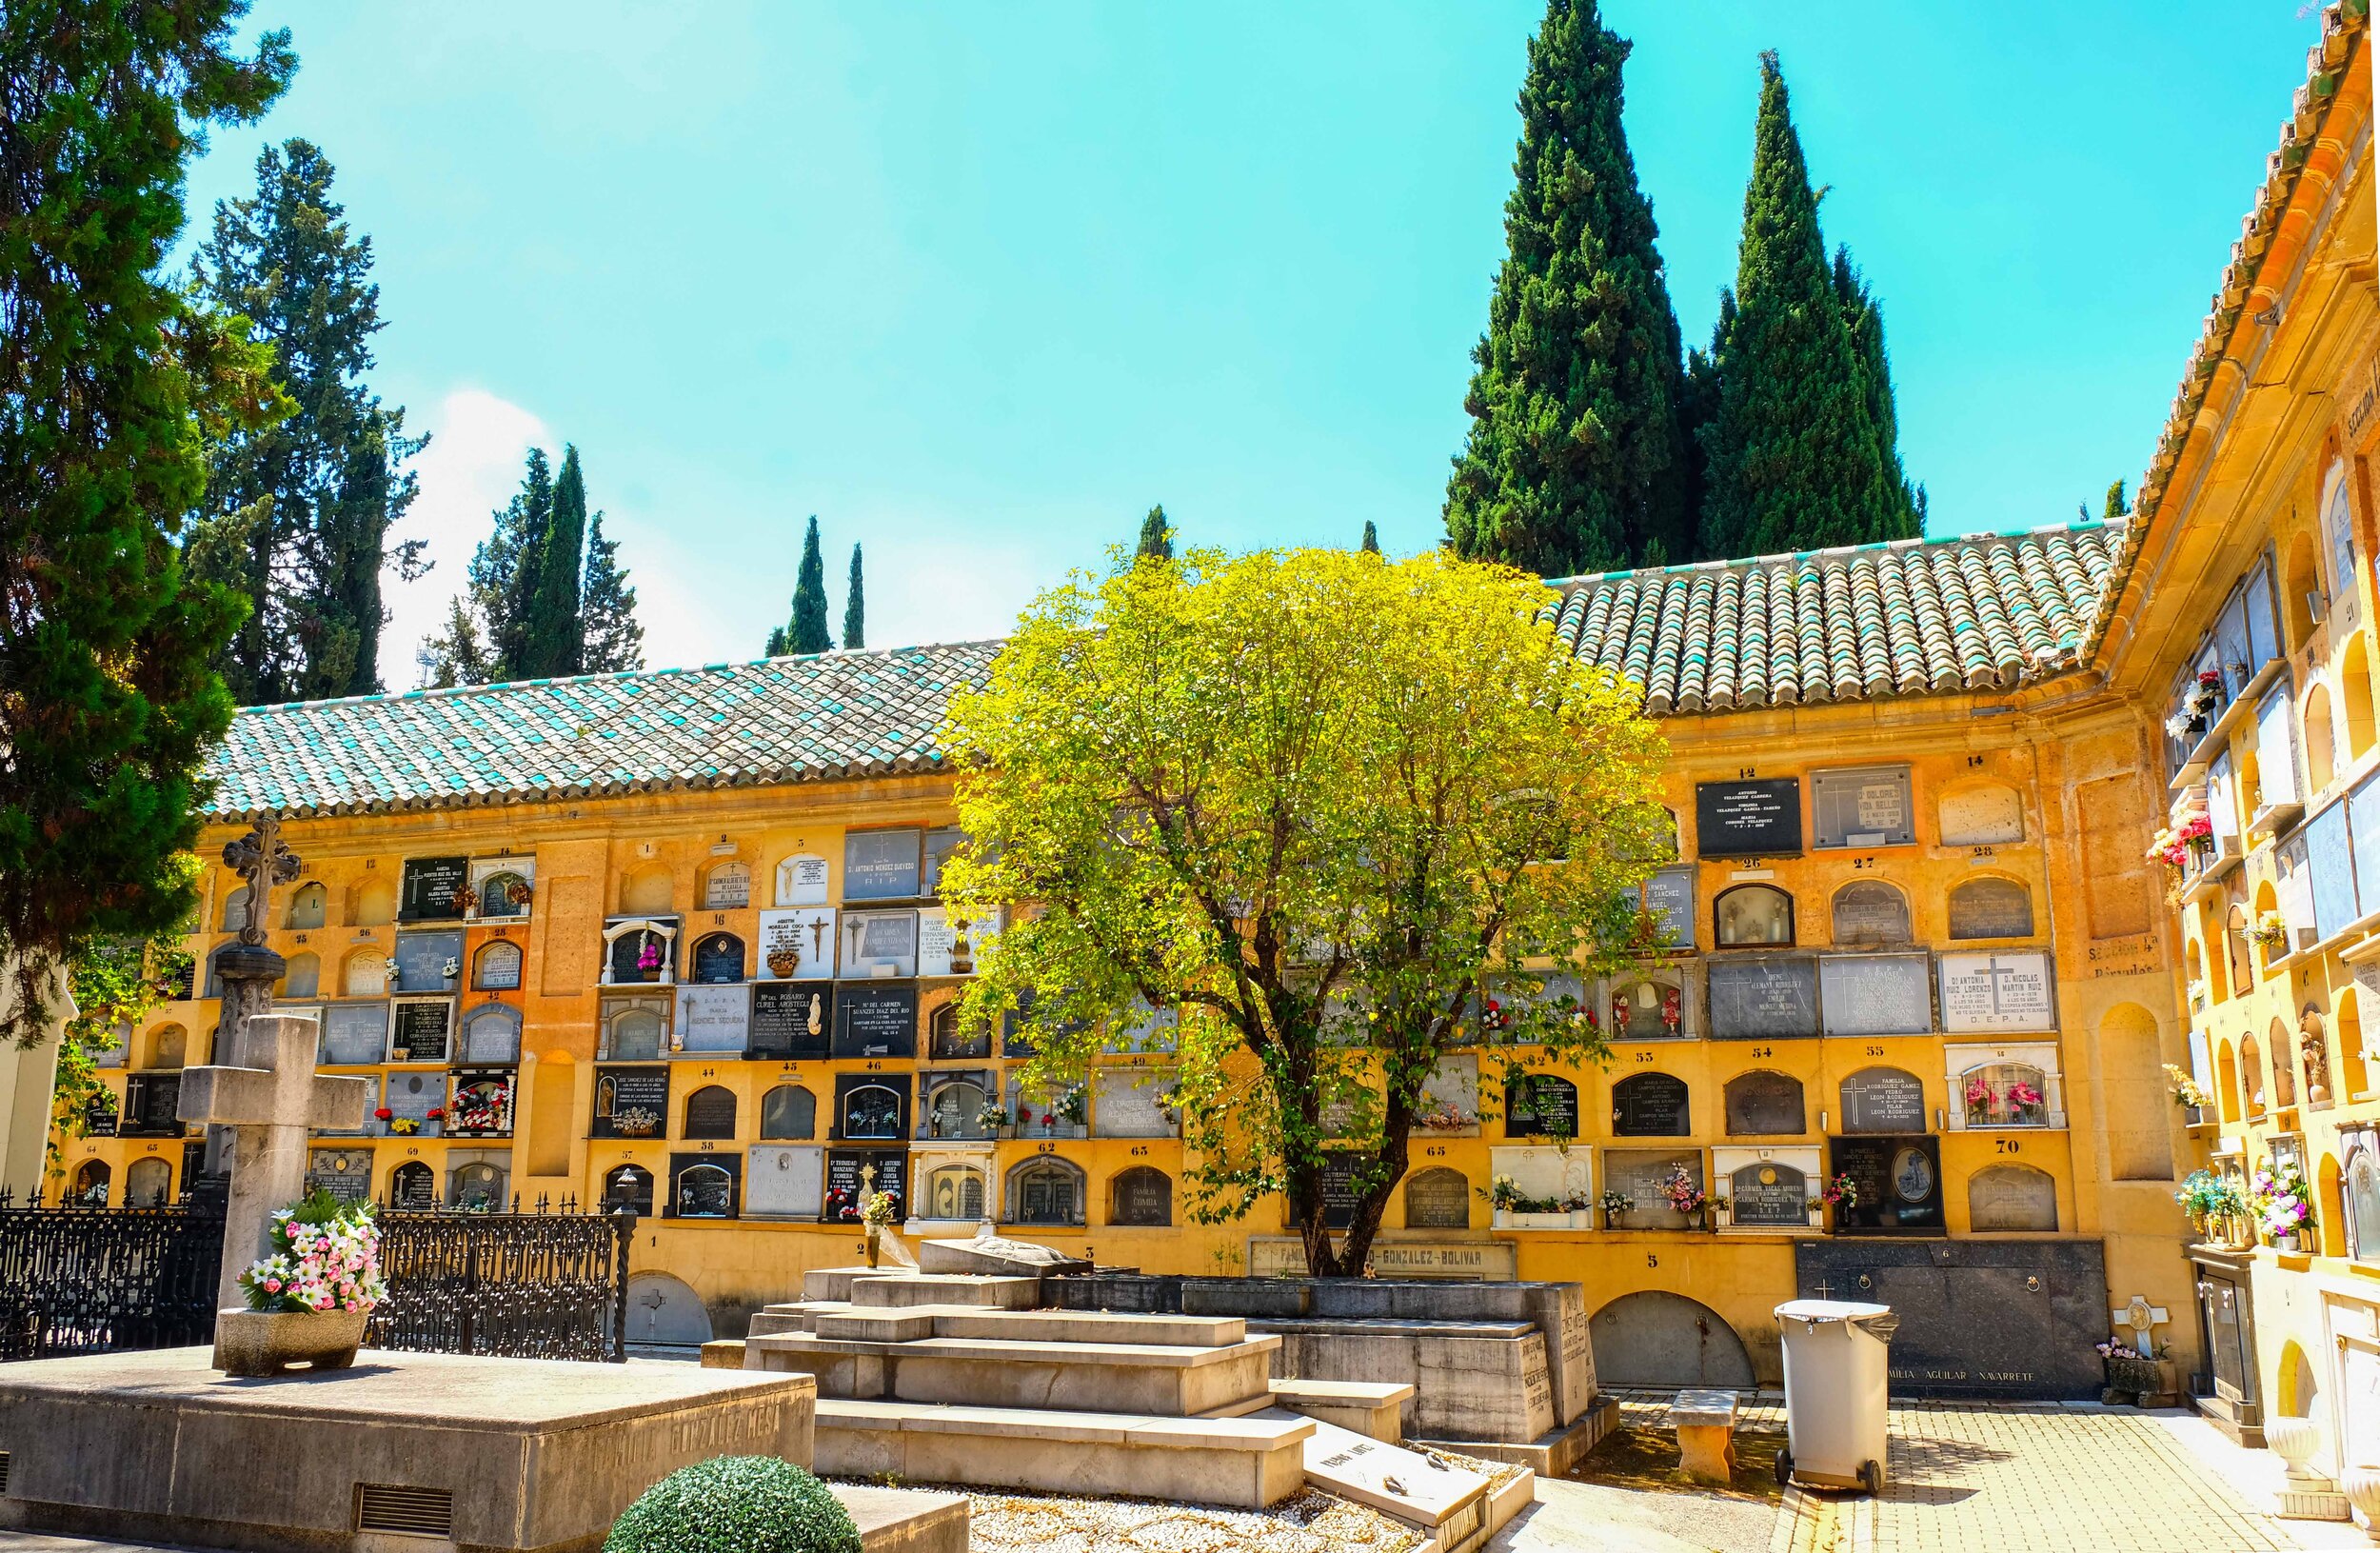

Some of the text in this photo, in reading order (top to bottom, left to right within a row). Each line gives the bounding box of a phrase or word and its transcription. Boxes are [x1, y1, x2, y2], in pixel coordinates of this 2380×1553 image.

[1967, 756, 1984, 767] 14
[1740, 767, 1755, 779] 12
[1866, 789, 1899, 798] DOLORES
[1973, 846, 1993, 857] 28
[367, 859, 375, 868] 12
[1743, 858, 1760, 868] 26
[1854, 857, 1874, 868] 27
[715, 915, 724, 926] 16
[1959, 975, 1985, 985] ANTONIA
[2012, 974, 2038, 983] NICOLAS
[1946, 985, 1992, 994] RUIZ LORENZO
[2002, 983, 2042, 992] MARTIN RUIZ
[1753, 1047, 1772, 1058] 54
[1866, 1045, 1884, 1056] 55
[783, 1063, 798, 1071] 45
[866, 1062, 882, 1070] 46
[703, 1068, 715, 1077] 44
[701, 1142, 714, 1150] 58
[1039, 1143, 1055, 1152] 62
[1427, 1146, 1446, 1156] 65
[1995, 1140, 2019, 1154] 70
[407, 1147, 419, 1156] 69
[622, 1150, 633, 1159] 57
[1085, 1247, 1094, 1258] 3
[1280, 1247, 1306, 1263] FAMIL
[1942, 1249, 1950, 1258] 6
[1648, 1254, 1657, 1268] 5
[1925, 1369, 1967, 1380] AGUILAR
[1978, 1371, 2035, 1381] NAVARRETE
[747, 1403, 781, 1440] MESA
